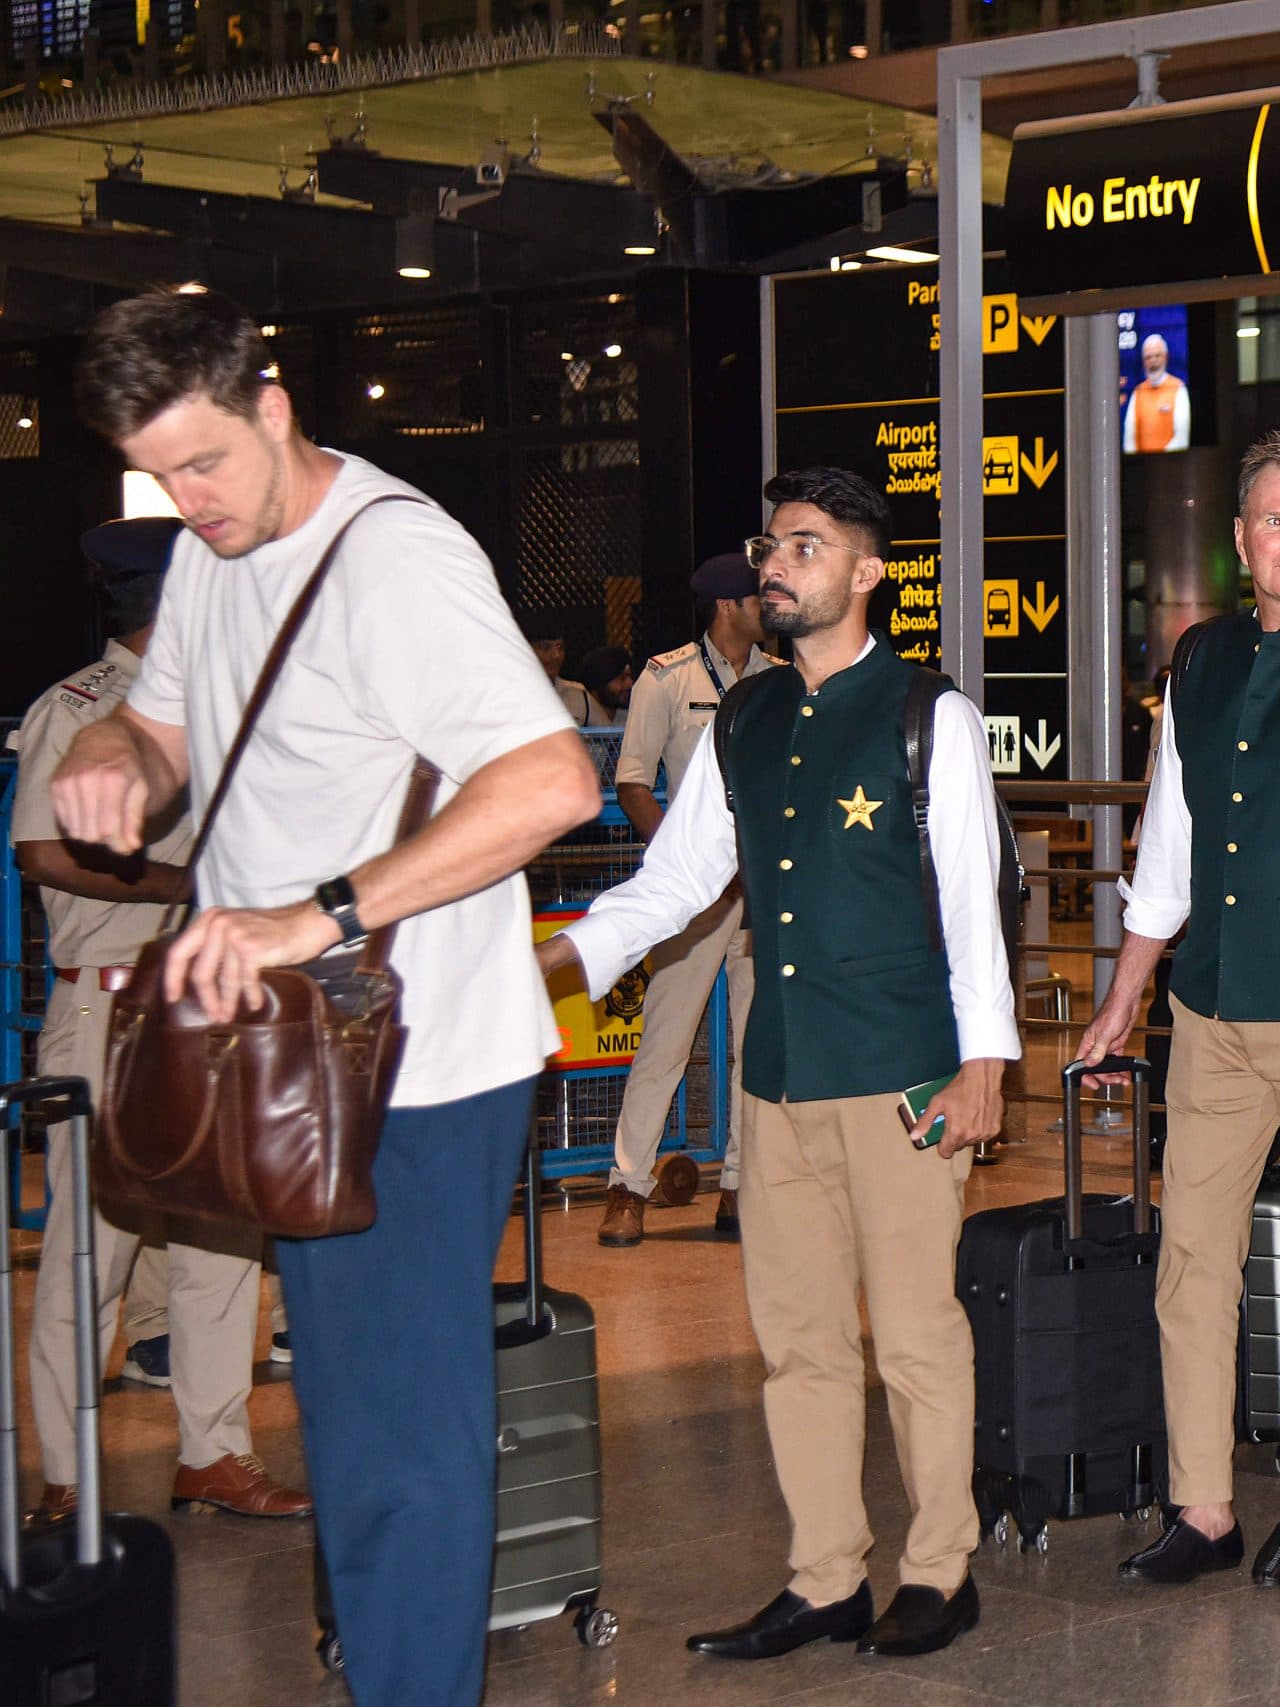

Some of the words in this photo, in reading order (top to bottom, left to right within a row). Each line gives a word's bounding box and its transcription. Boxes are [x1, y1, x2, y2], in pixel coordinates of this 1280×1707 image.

[1047, 185, 1094, 229] No
[1103, 176, 1200, 224] Entry
[876, 422, 936, 450] Airport
[888, 445, 937, 474] एयरपोर्ट
[882, 554, 935, 584] repaid
